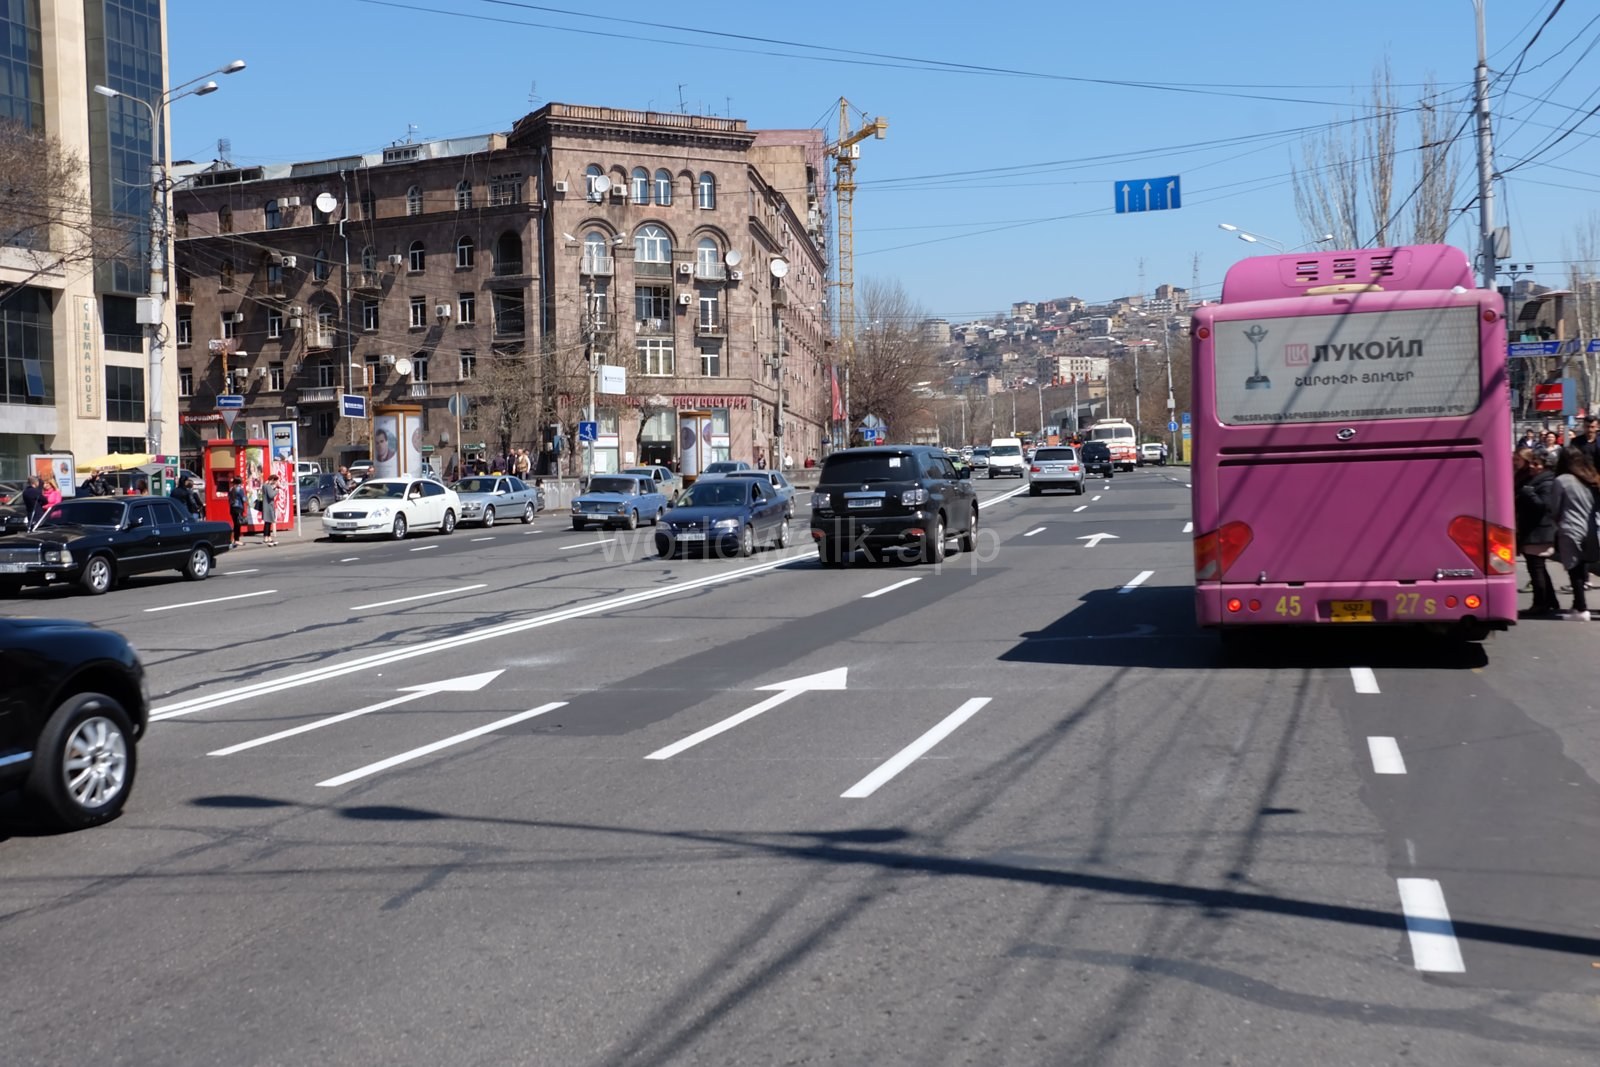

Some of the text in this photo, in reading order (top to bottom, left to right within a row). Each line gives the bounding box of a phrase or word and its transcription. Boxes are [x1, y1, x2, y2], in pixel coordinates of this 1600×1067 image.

[82, 303, 93, 413] CINEMA HOUSE
[1312, 336, 1423, 363] ЛУКОЙЛ
[1275, 595, 1302, 617] 45
[1395, 593, 1420, 615] 27
